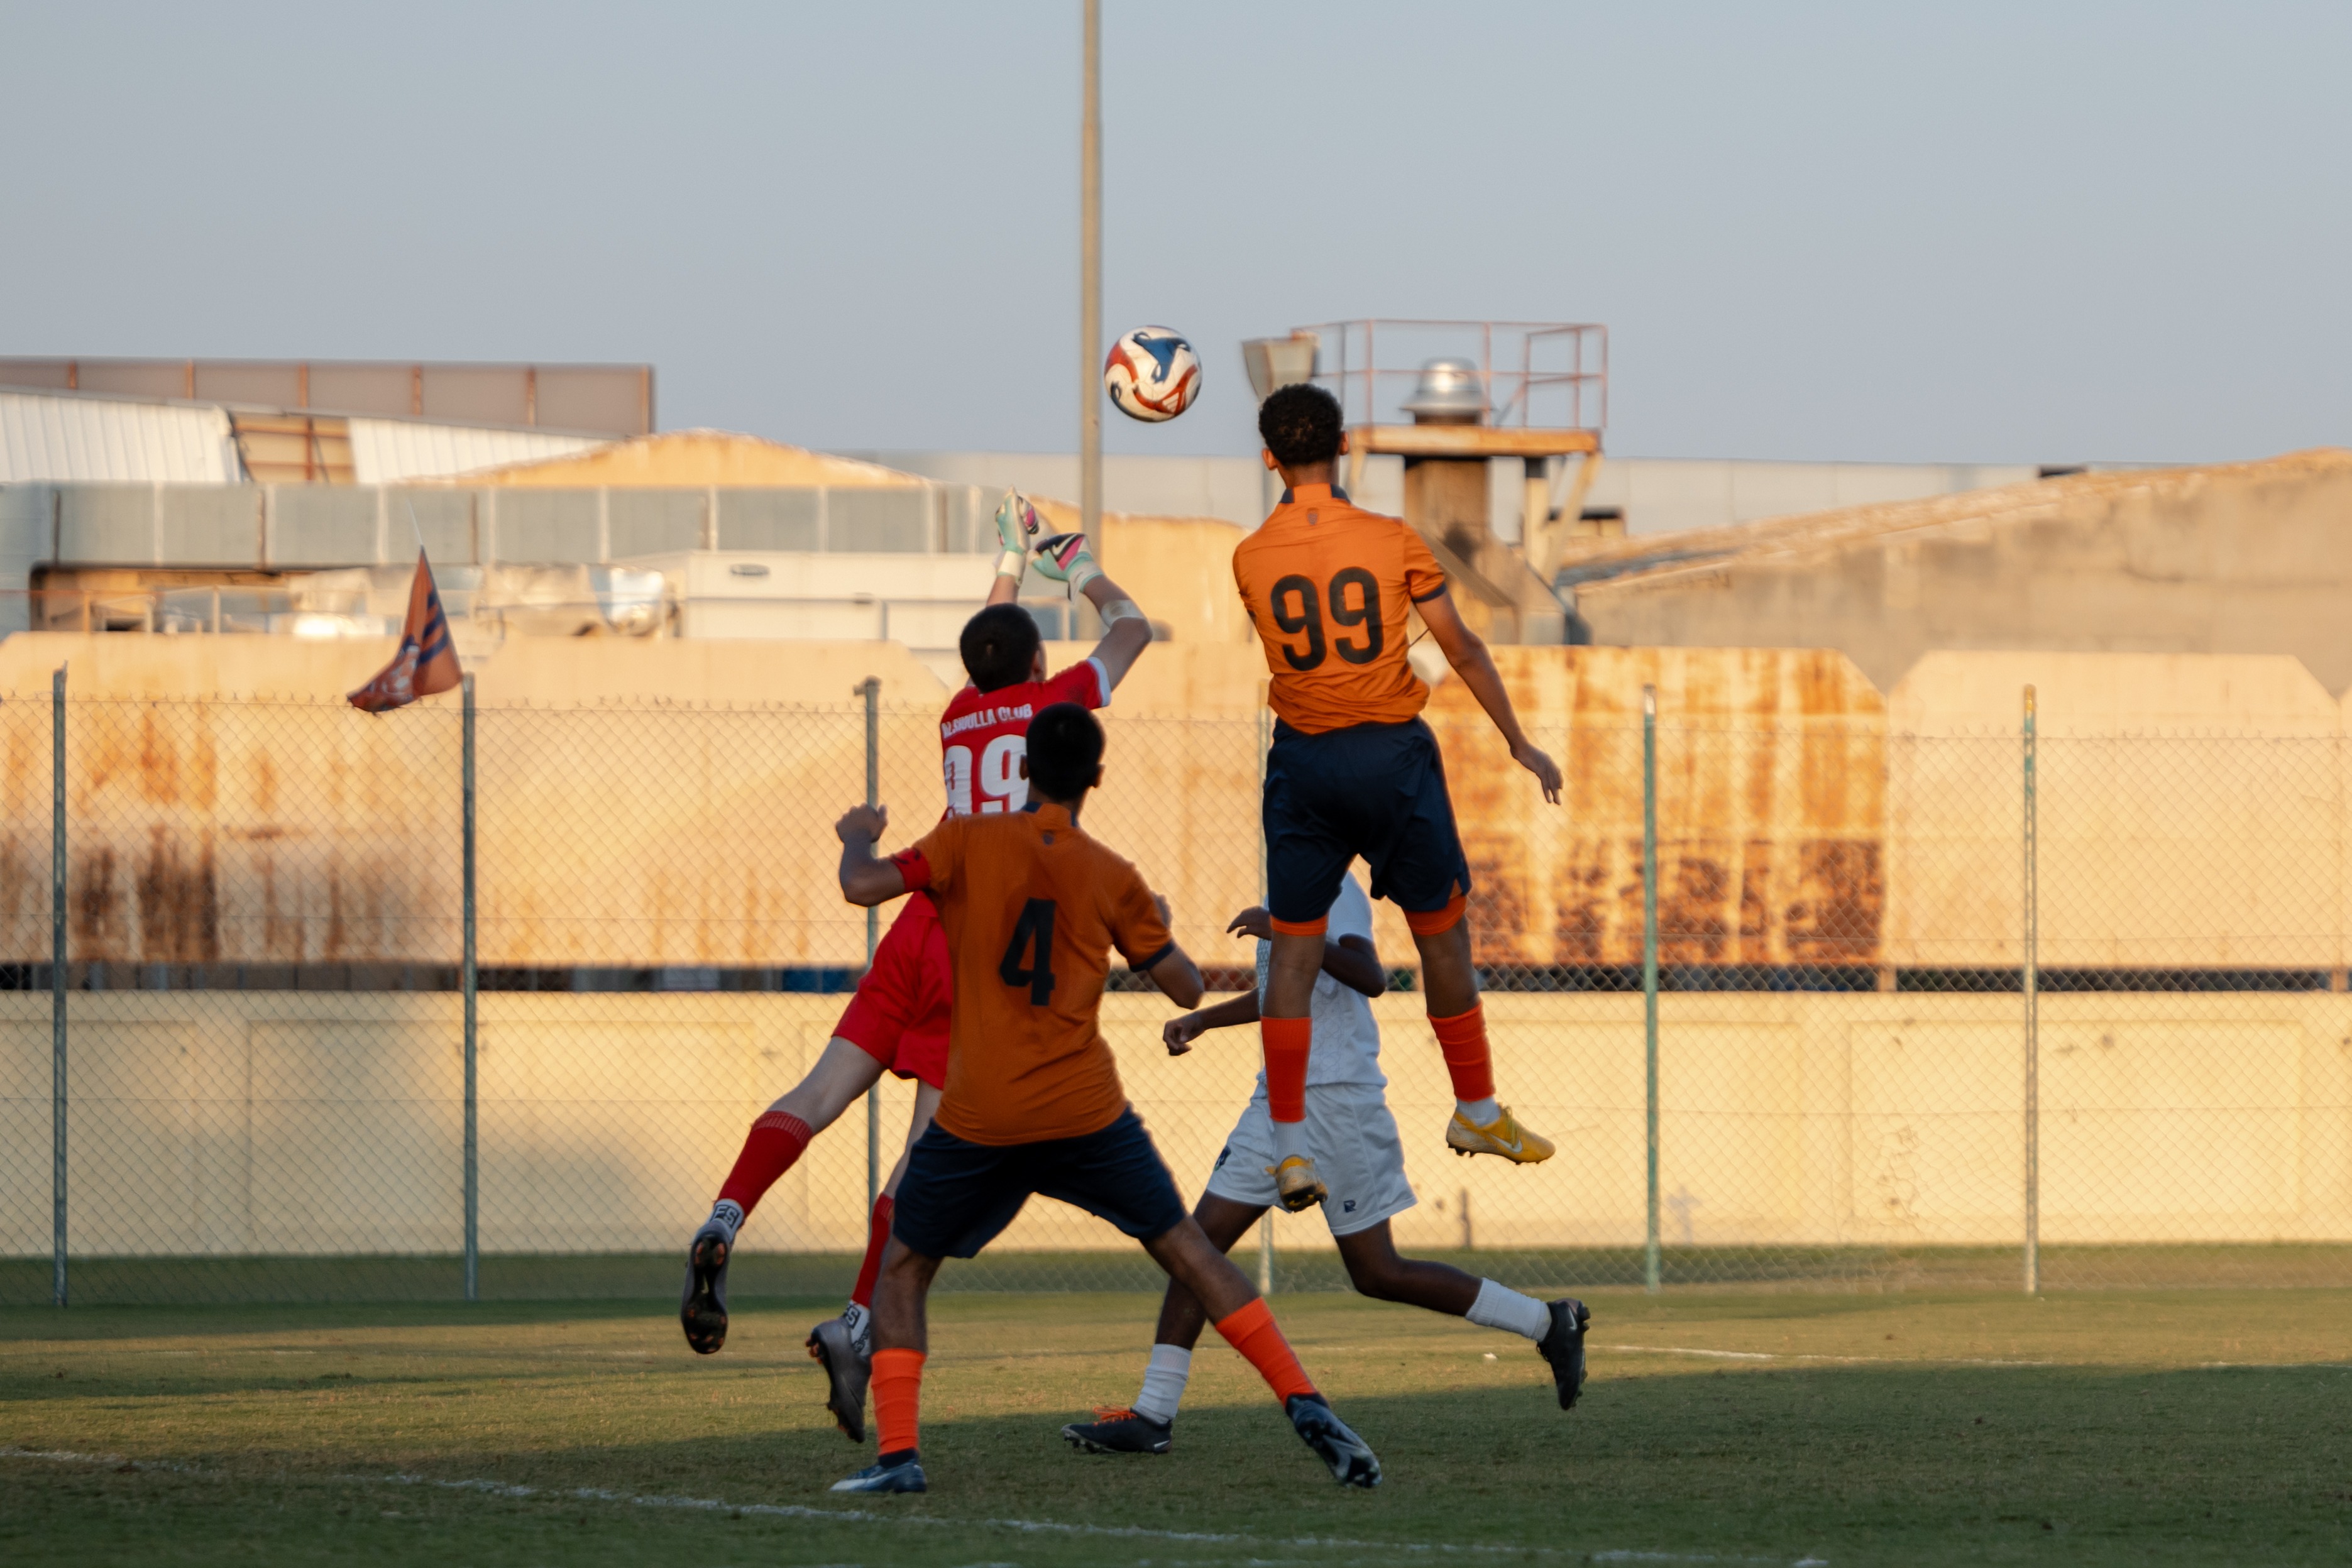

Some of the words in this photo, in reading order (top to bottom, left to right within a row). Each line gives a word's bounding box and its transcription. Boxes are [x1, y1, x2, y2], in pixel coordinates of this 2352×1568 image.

[1271, 566, 1383, 671] 99
[997, 703, 1032, 721] CLUB
[999, 897, 1056, 1006] 4
